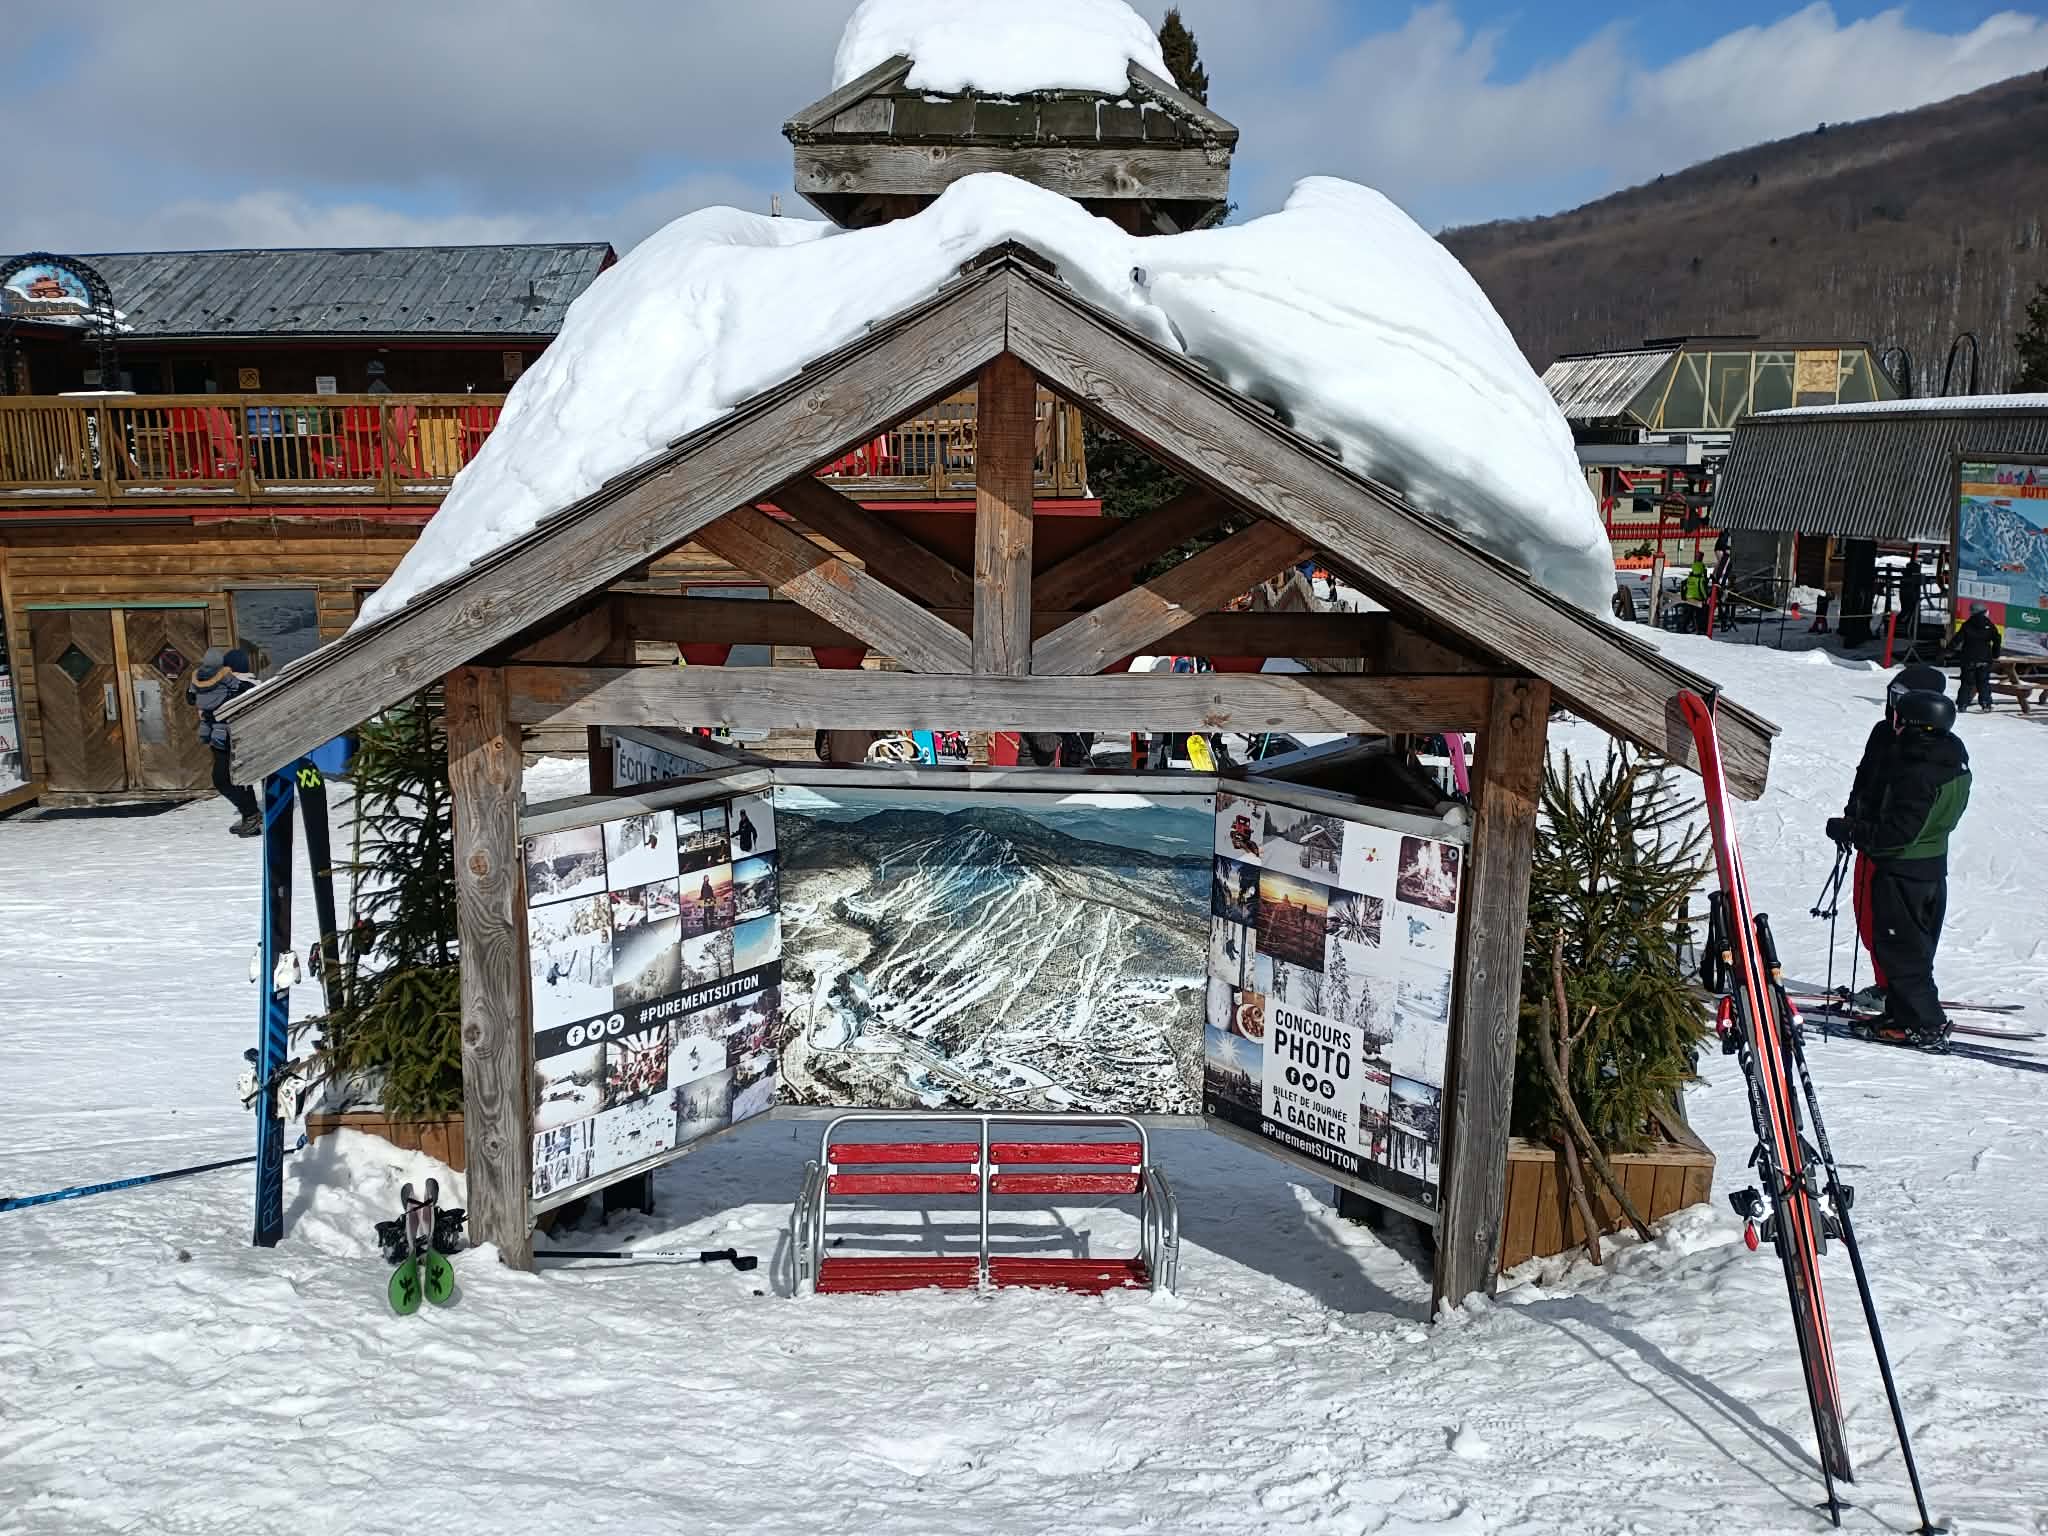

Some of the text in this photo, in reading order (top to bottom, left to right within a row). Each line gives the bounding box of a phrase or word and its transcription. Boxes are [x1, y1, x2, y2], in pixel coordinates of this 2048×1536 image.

[639, 974, 759, 1024] #PUREMENTSUTTON
[1275, 1009, 1351, 1050] CONCOURS
[1275, 1028, 1350, 1080] PHOTO
[1273, 1085, 1348, 1123] BILLET DE JOURNÉE
[1273, 1096, 1346, 1144] À GAGNER
[1262, 1121, 1359, 1173] #PurementSUTTON
